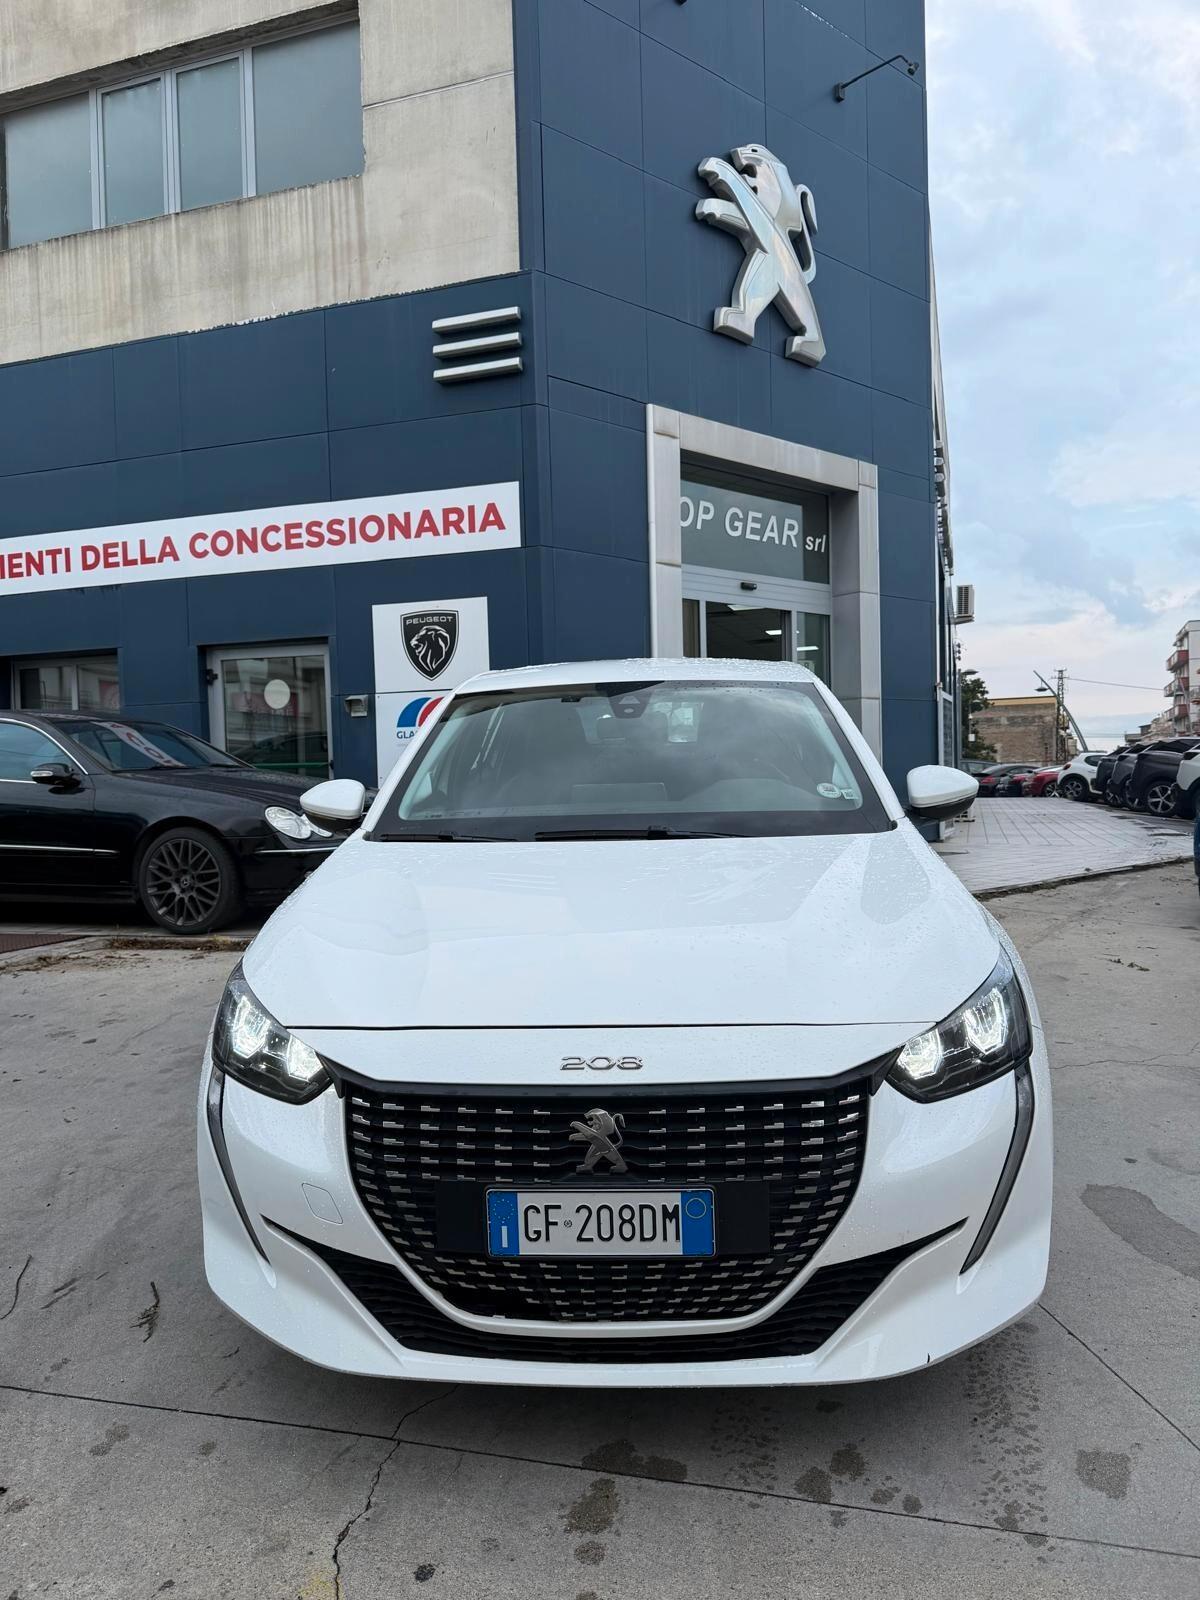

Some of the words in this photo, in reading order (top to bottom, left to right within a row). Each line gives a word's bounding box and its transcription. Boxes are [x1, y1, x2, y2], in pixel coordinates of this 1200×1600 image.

[81, 536, 180, 571] DELLA
[189, 501, 506, 559] CONCESSIONARIA
[725, 507, 799, 548] GEAR
[805, 535, 826, 552] srl
[406, 616, 454, 625] PEUGEOT
[397, 730, 417, 739] GLA
[560, 1056, 644, 1071] 208
